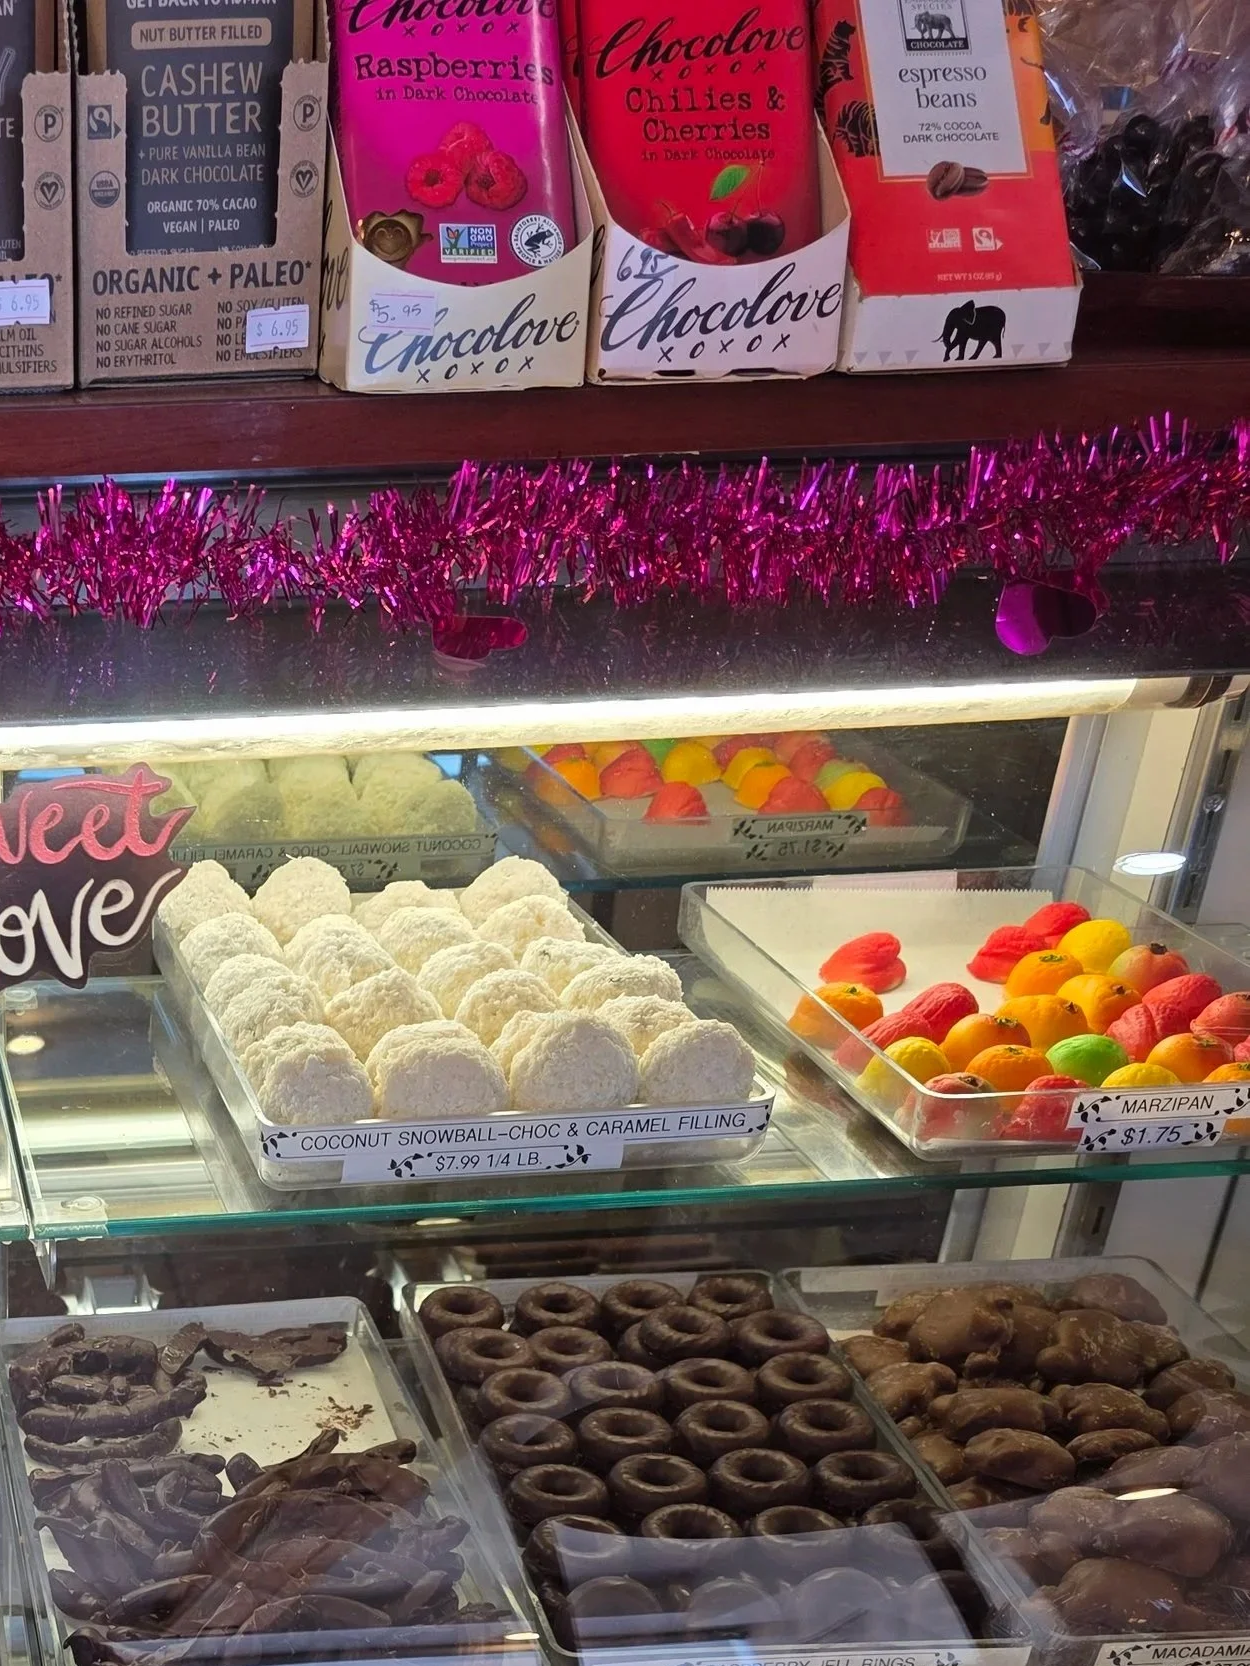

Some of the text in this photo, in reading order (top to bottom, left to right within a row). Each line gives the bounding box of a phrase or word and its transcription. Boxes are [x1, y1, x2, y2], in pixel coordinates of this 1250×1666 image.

[140, 25, 262, 43] NUT BUTTER FILLED
[594, 7, 805, 79] Chocolove
[911, 41, 965, 49] CHOCOLATE
[354, 52, 554, 86] Raspberries
[898, 66, 986, 88] espresso
[141, 62, 262, 98] CASHEW
[377, 86, 538, 104] in Dark Chocolate
[625, 85, 785, 113] Chilies &
[916, 88, 977, 108] beans
[141, 102, 262, 137] BUTTER
[918, 122, 982, 131] 72% COCOA
[643, 118, 771, 142] Cherries
[903, 132, 999, 143] DARK CHOCOLATE
[150, 146, 178, 160] PURE
[183, 145, 230, 159] VANILLA
[236, 144, 265, 157] BEAN
[142, 164, 264, 186] DARK CHOCOLATE
[147, 197, 257, 214] ORGANIC 70% CACAO
[163, 218, 240, 233] VEGAN PALEO
[470, 227, 492, 235] NON
[470, 234, 493, 242] GMO
[443, 248, 494, 256] VERIFIED
[600, 262, 842, 351] Chocolove
[1121, 1095, 1214, 1114] MARZIPAN
[301, 1132, 392, 1151] COCONUT
[567, 1121, 579, 1137] &
[586, 1118, 671, 1136] CARAMEL
[678, 1112, 746, 1130] FILLING
[1121, 1125, 1183, 1146] $1.75
[435, 1150, 543, 1172] $7.99 1/4 LB.
